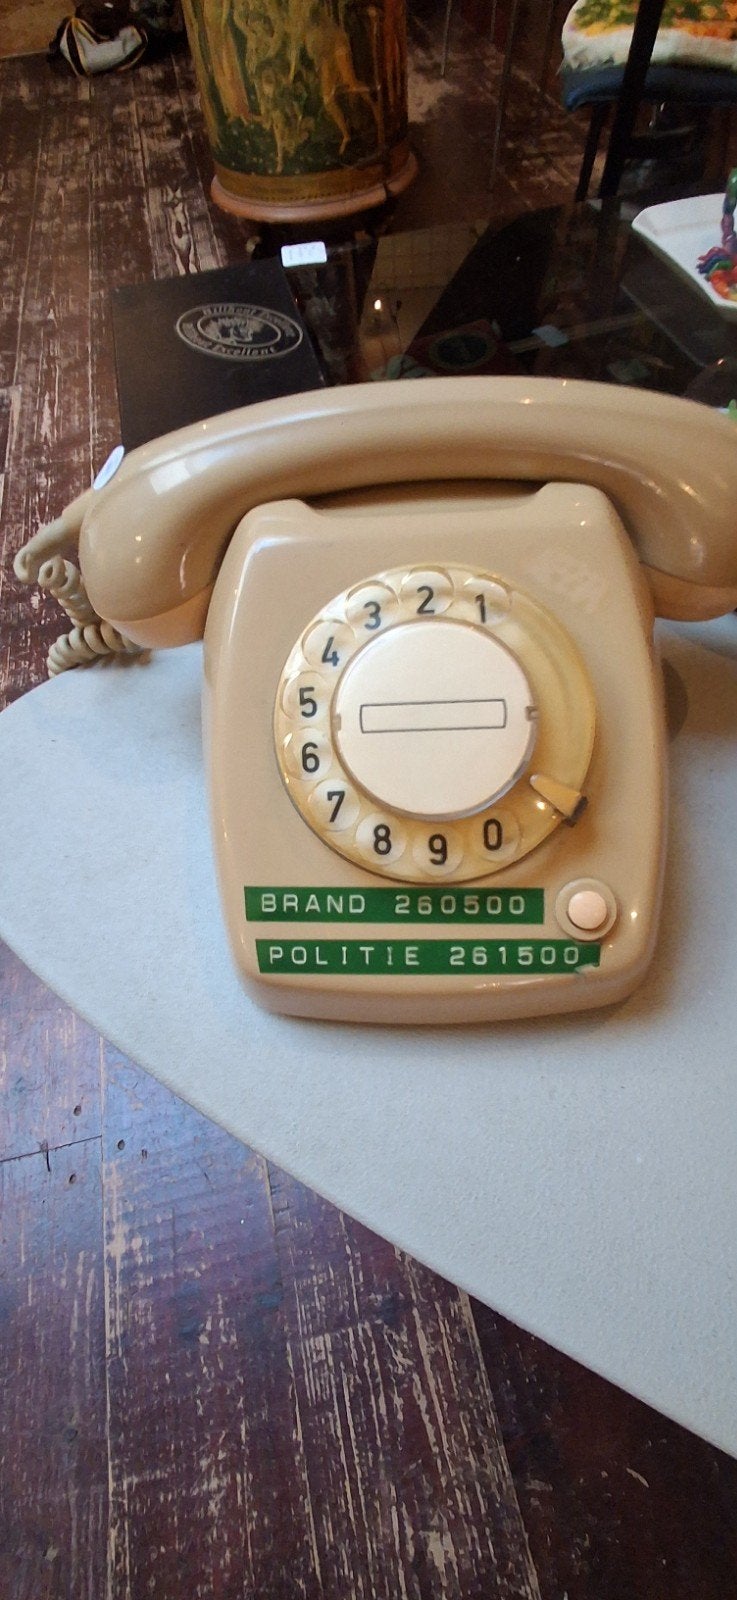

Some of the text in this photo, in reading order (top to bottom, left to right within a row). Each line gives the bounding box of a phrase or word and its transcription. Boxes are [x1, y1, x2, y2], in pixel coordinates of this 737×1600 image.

[416, 585, 435, 614] 2
[475, 594, 487, 624] 1
[364, 601, 381, 630] 3
[321, 636, 340, 666] 4
[298, 687, 317, 718] 5
[301, 742, 320, 773] 6
[327, 790, 345, 823] 7
[373, 824, 392, 855] 8
[483, 818, 502, 850] 0
[428, 834, 447, 865] 9
[260, 893, 526, 915] BRAND 260500
[268, 945, 579, 966] POLITIE 261500
